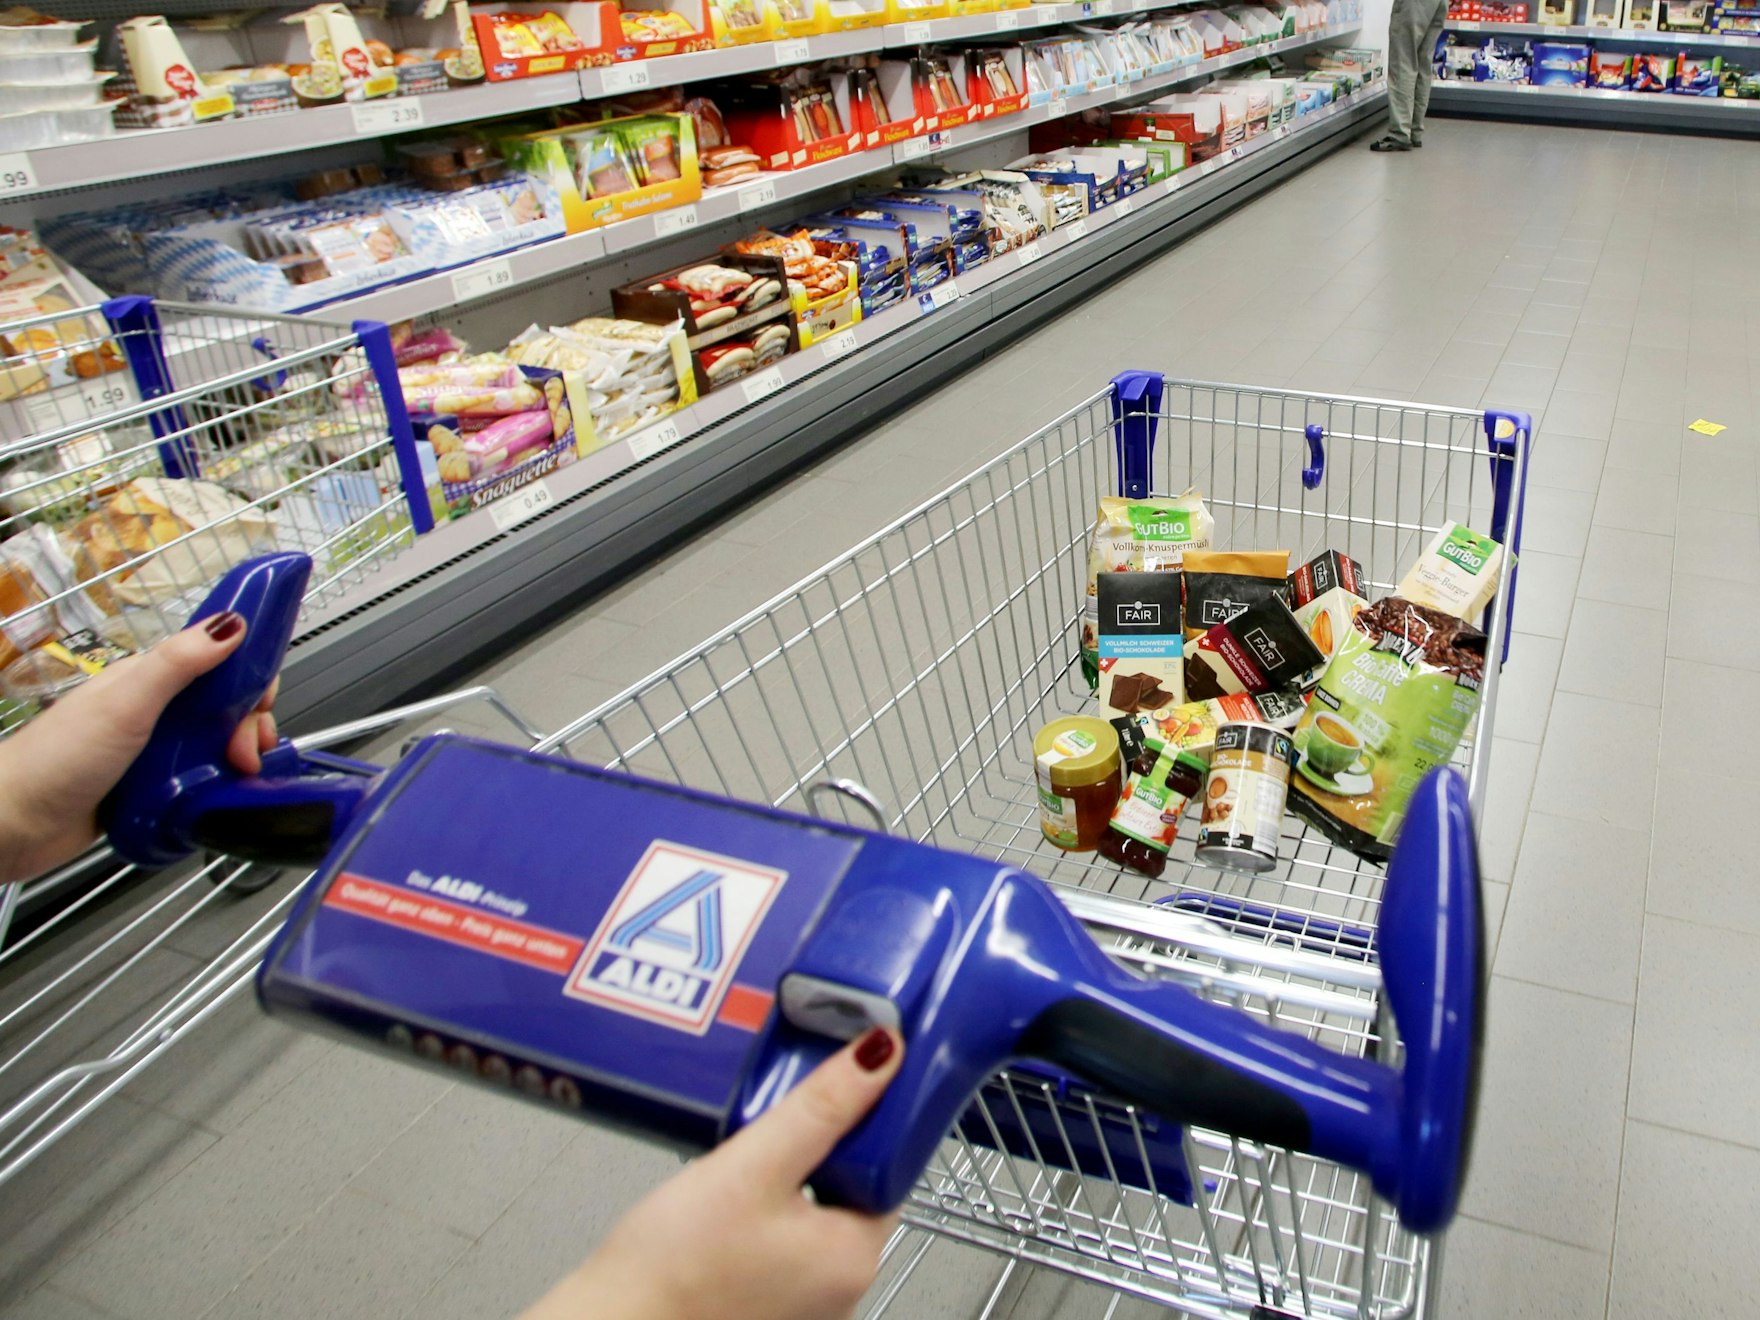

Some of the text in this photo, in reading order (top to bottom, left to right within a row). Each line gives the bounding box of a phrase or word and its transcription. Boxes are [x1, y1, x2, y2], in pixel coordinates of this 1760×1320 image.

[628, 72, 647, 84] 1.29
[392, 108, 418, 122] 2.39
[486, 271, 509, 287] 1.89
[86, 388, 124, 408] 1.99
[657, 427, 677, 442] 1.79
[472, 453, 558, 509] Snaquette
[524, 489, 547, 509] 0.49
[1125, 610, 1152, 620] FAIR
[1253, 636, 1275, 662] FAIR
[1341, 669, 1388, 706] CREMA
[1263, 697, 1280, 715] FAIR
[340, 882, 390, 906] Qualität
[430, 874, 484, 903] ALDI
[598, 957, 700, 1007] ALDI
